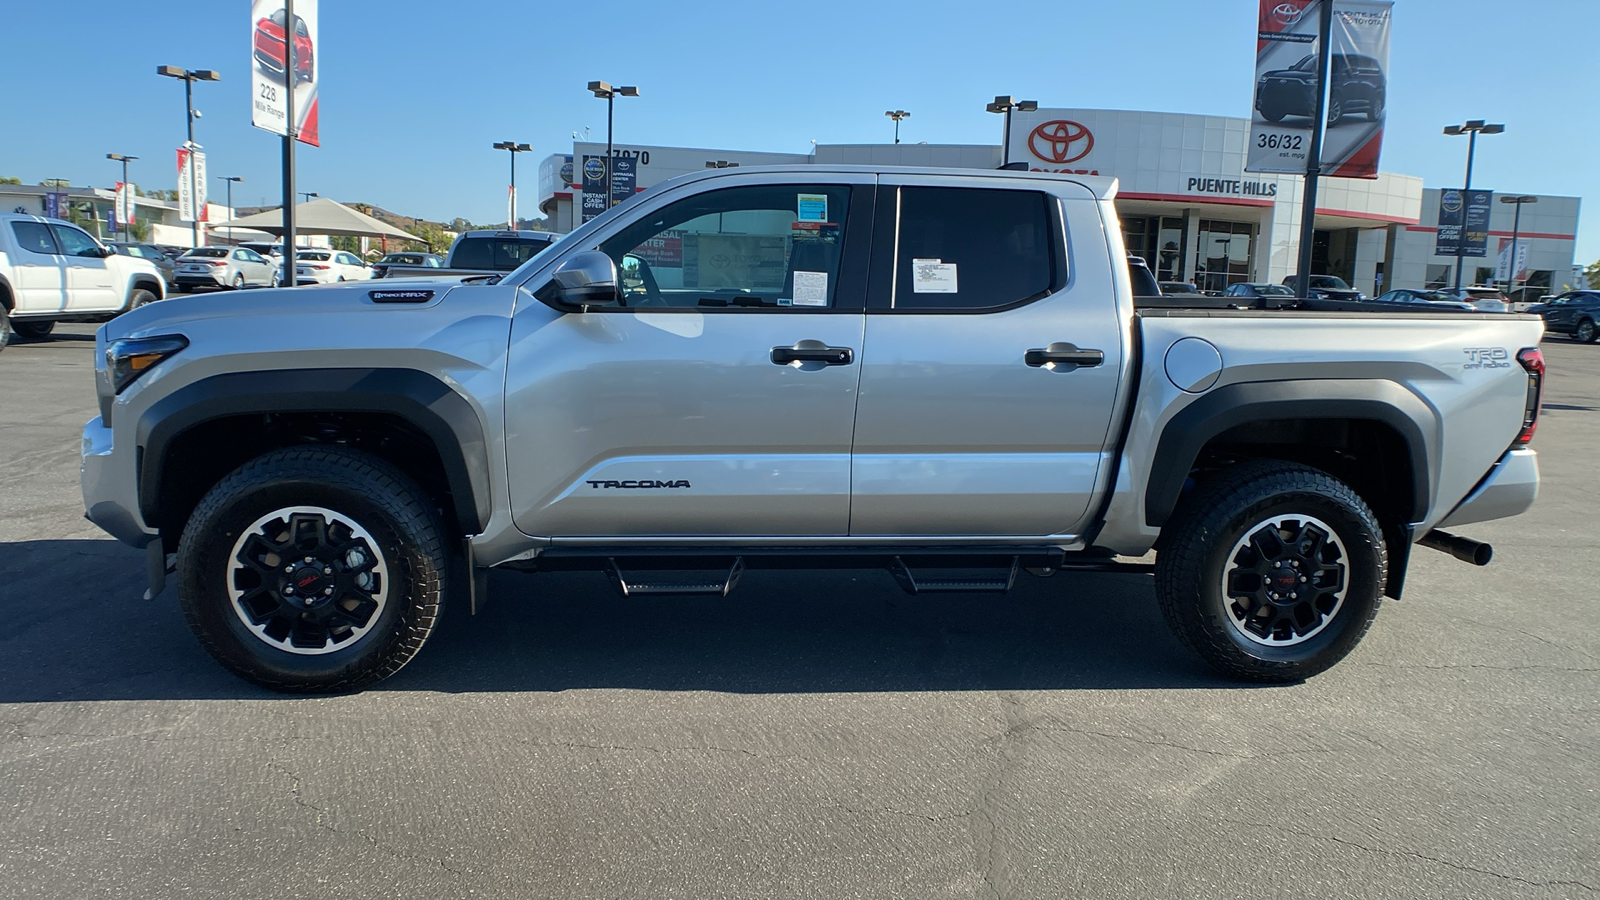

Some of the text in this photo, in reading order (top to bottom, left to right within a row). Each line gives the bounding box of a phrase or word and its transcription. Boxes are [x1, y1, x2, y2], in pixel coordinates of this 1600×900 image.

[260, 83, 277, 102] 228
[255, 100, 285, 120] Mile Range
[1257, 133, 1303, 150] 36/32
[1291, 152, 1306, 160] mpg
[1187, 177, 1277, 197] PUENTE HILLS
[1463, 346, 1508, 364] TRD
[586, 480, 691, 489] TACOMA
